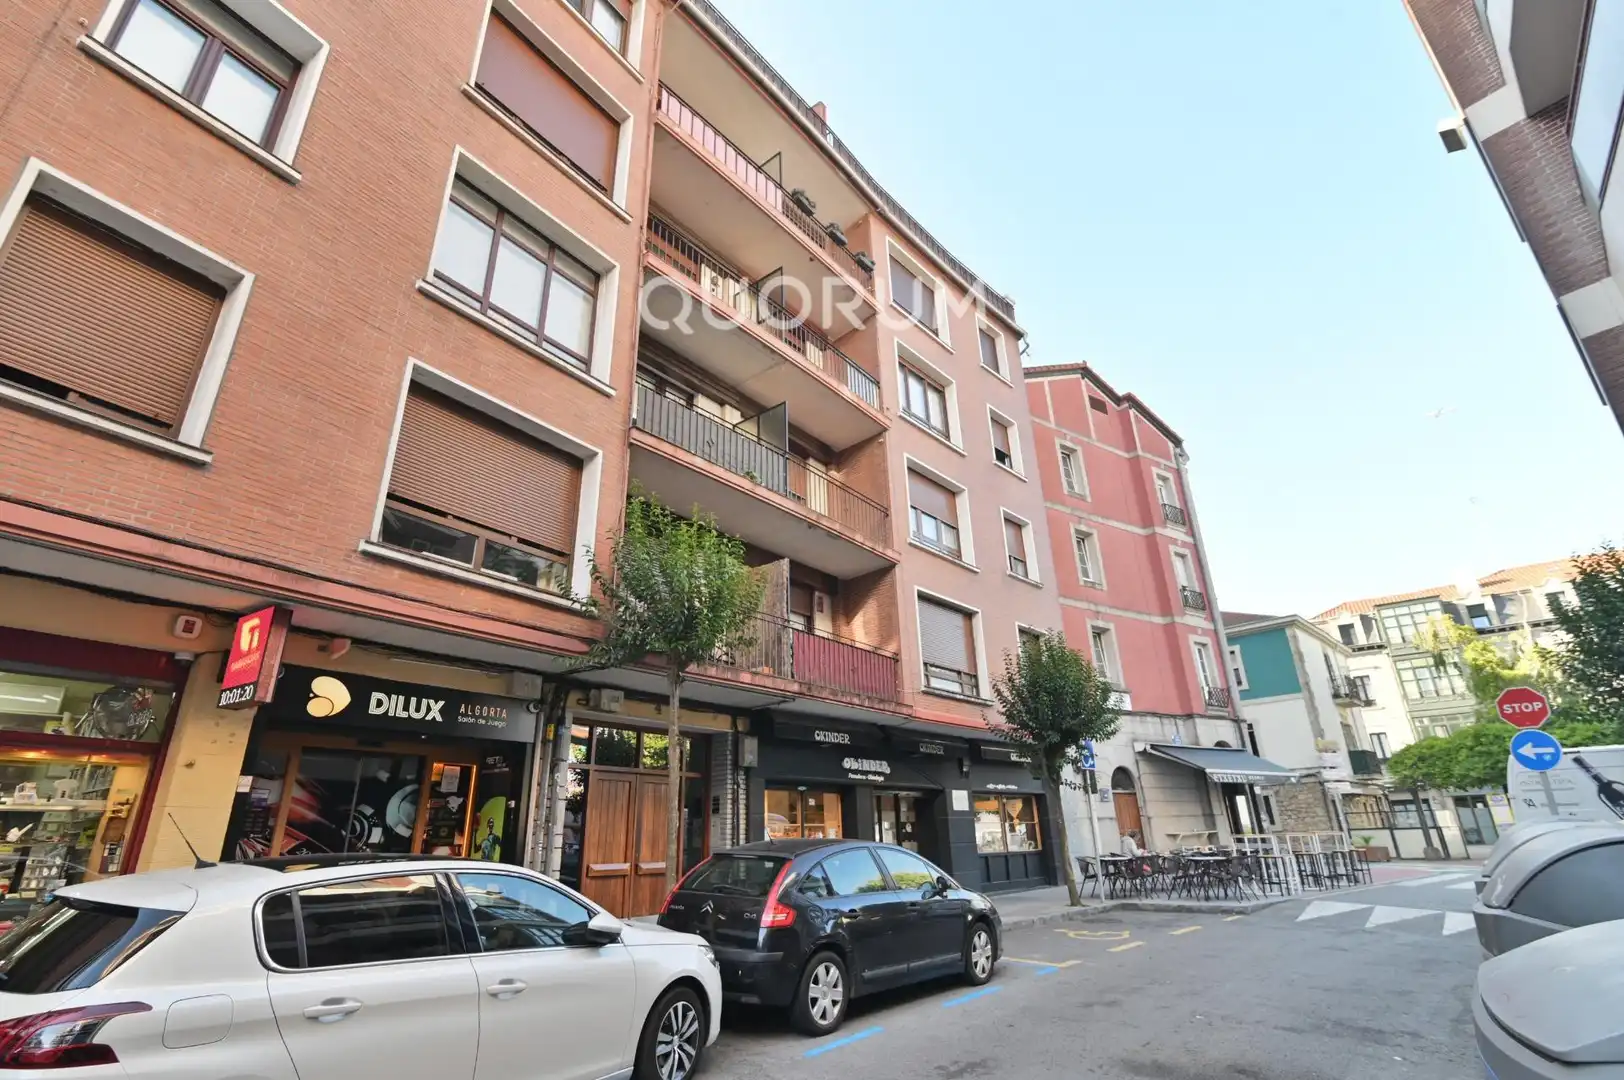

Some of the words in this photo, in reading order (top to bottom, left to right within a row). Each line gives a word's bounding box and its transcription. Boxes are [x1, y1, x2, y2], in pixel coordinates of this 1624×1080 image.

[219, 685, 254, 706] 10:01:20
[368, 691, 445, 722] DILUX
[459, 703, 508, 719] ALGORTA
[1503, 702, 1543, 714] STOP
[814, 730, 851, 744] OKINDER
